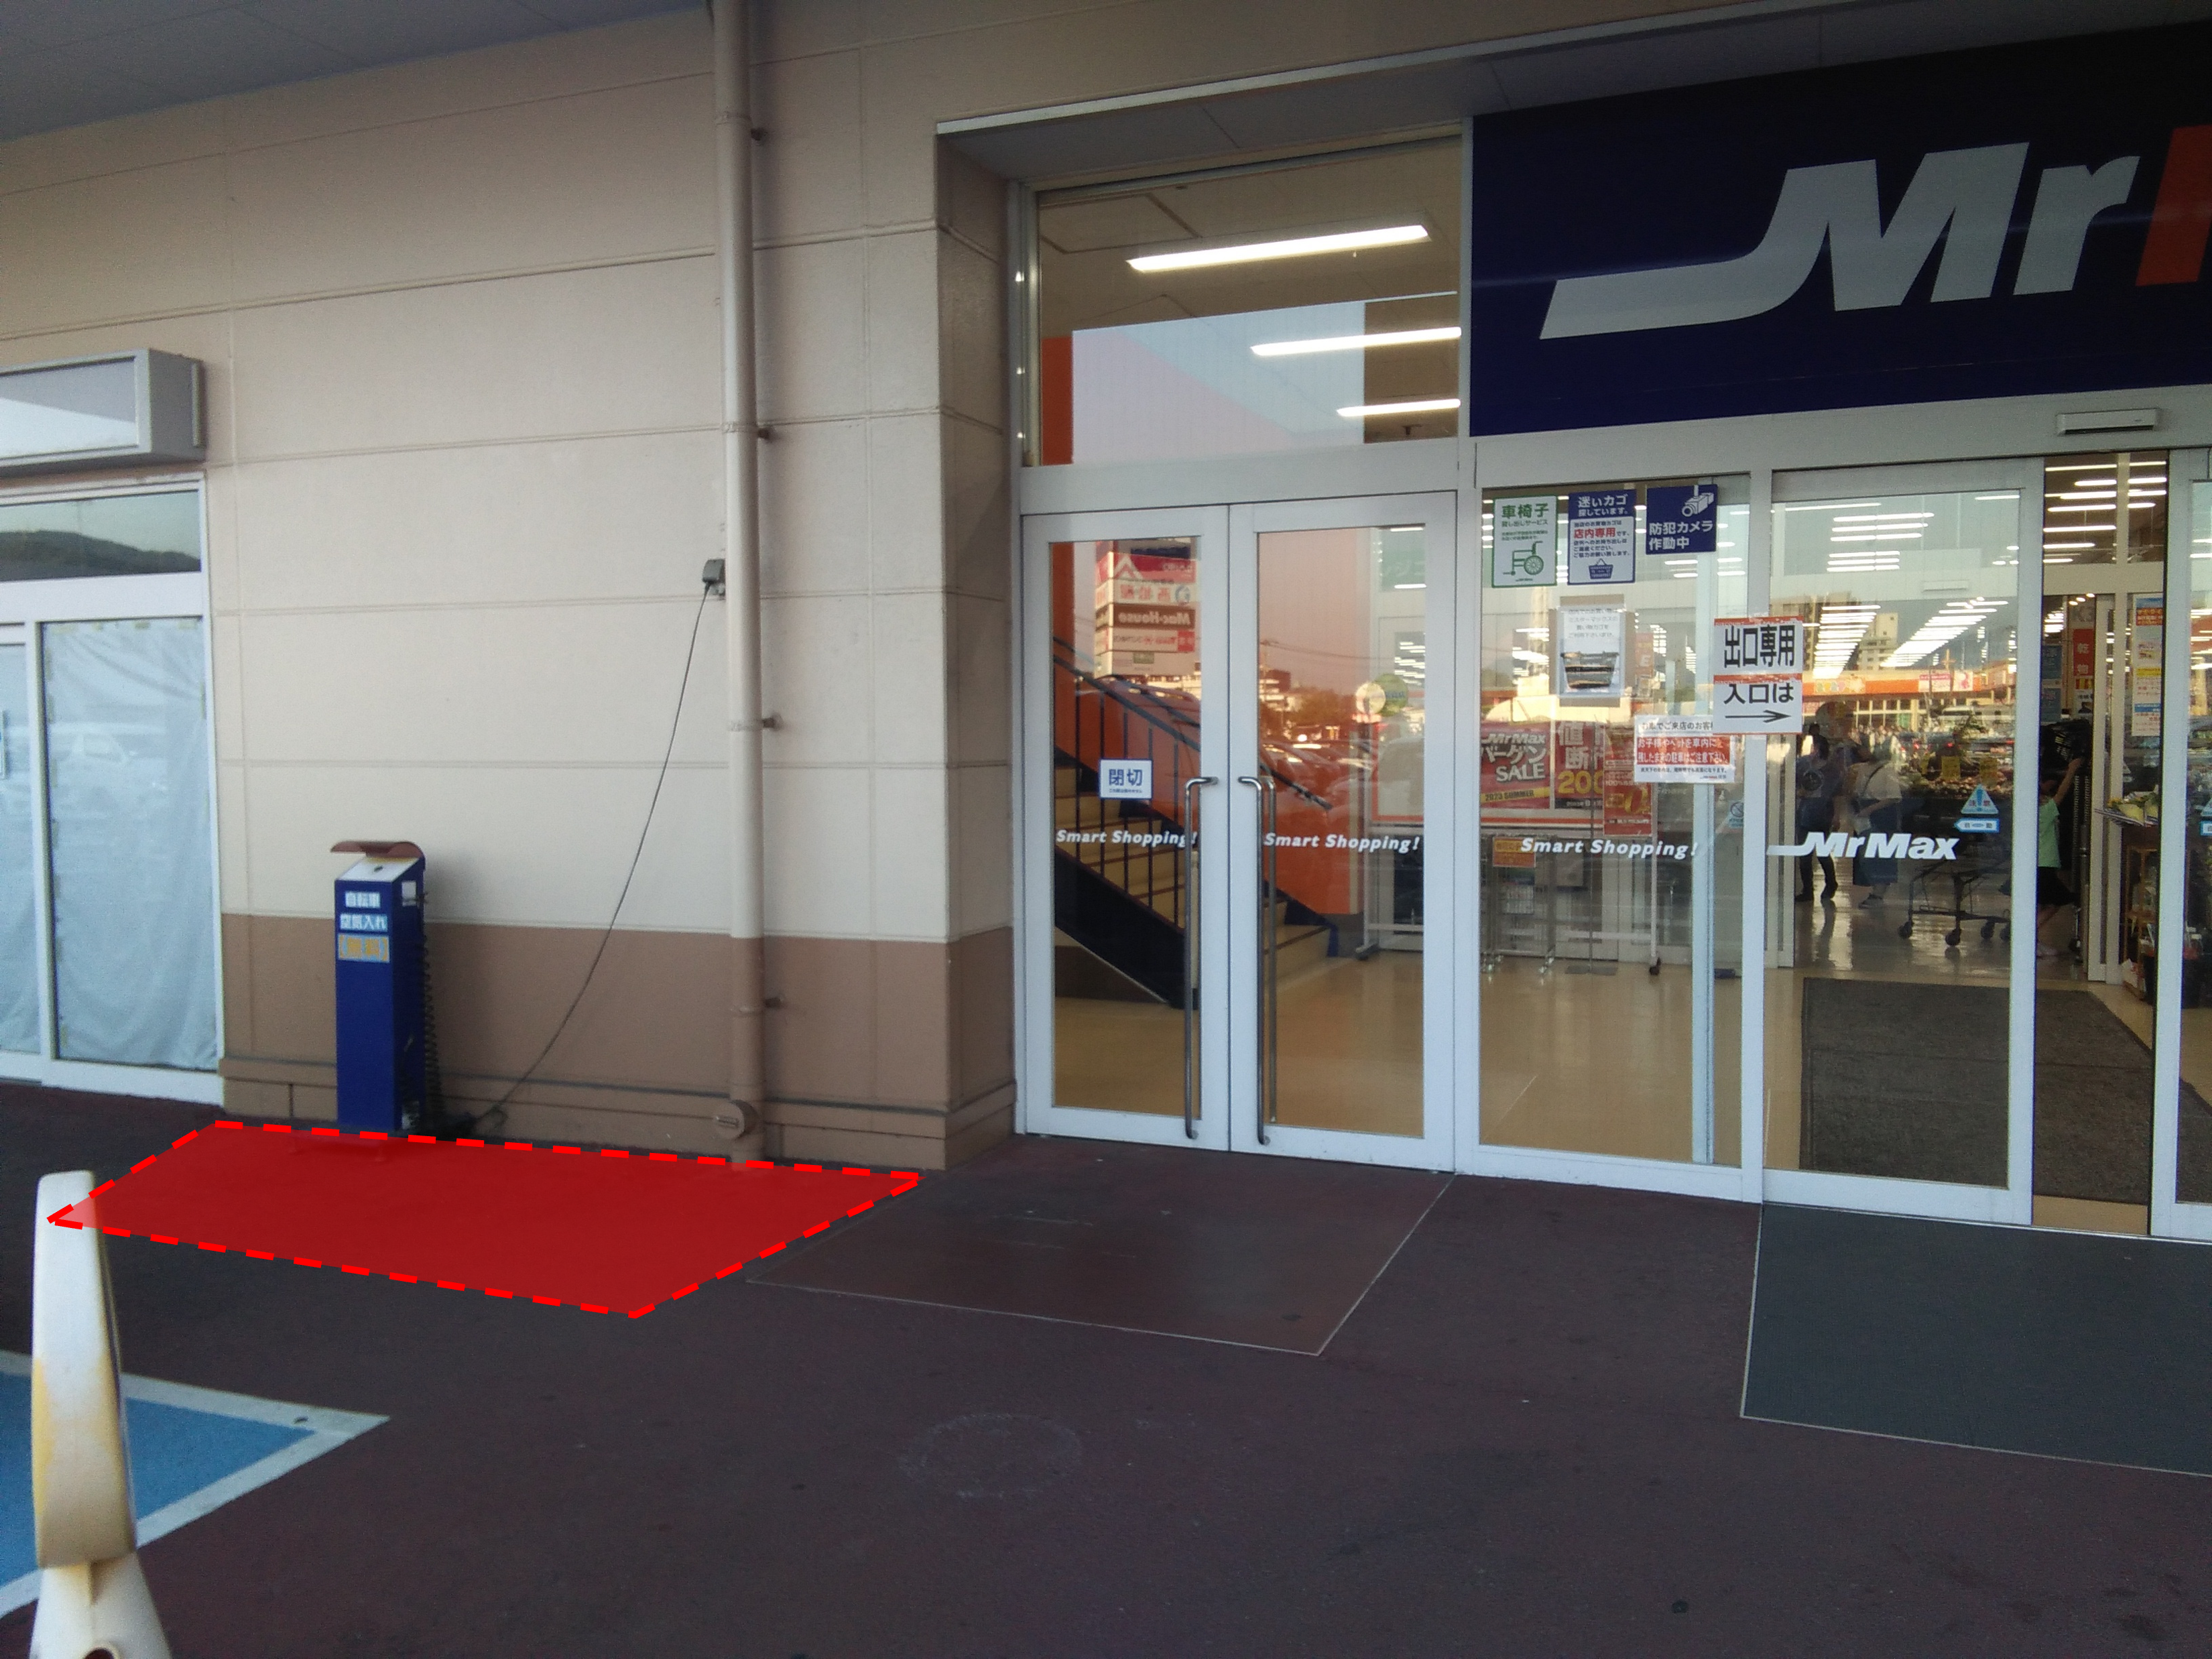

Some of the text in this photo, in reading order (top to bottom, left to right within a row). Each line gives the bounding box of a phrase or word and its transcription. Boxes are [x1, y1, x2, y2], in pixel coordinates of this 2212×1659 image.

[1578, 494, 1629, 508] 迷いカゴ
[1502, 503, 1548, 519] 車椅子
[1579, 507, 1628, 517] 探しています。
[1649, 520, 1713, 536] 防犯カメラ
[1649, 536, 1689, 550] 作動中
[1724, 624, 1795, 668] 出口専用
[1723, 683, 1794, 704] 入口は
[1642, 721, 1713, 731] お車でご来店のお客
[1481, 733, 1546, 744] MrMax
[1481, 745, 1547, 765] バーゲン
[1109, 768, 1143, 786] 閉切
[1496, 763, 1546, 790] SALE
[1056, 830, 1107, 843] Smart
[1264, 832, 1420, 854] Smart Shopping!
[1766, 831, 1960, 860] MrMax
[1521, 838, 1584, 854] Smart
[1590, 839, 1699, 859] Shopping!
[340, 913, 387, 931] 空気入れ
